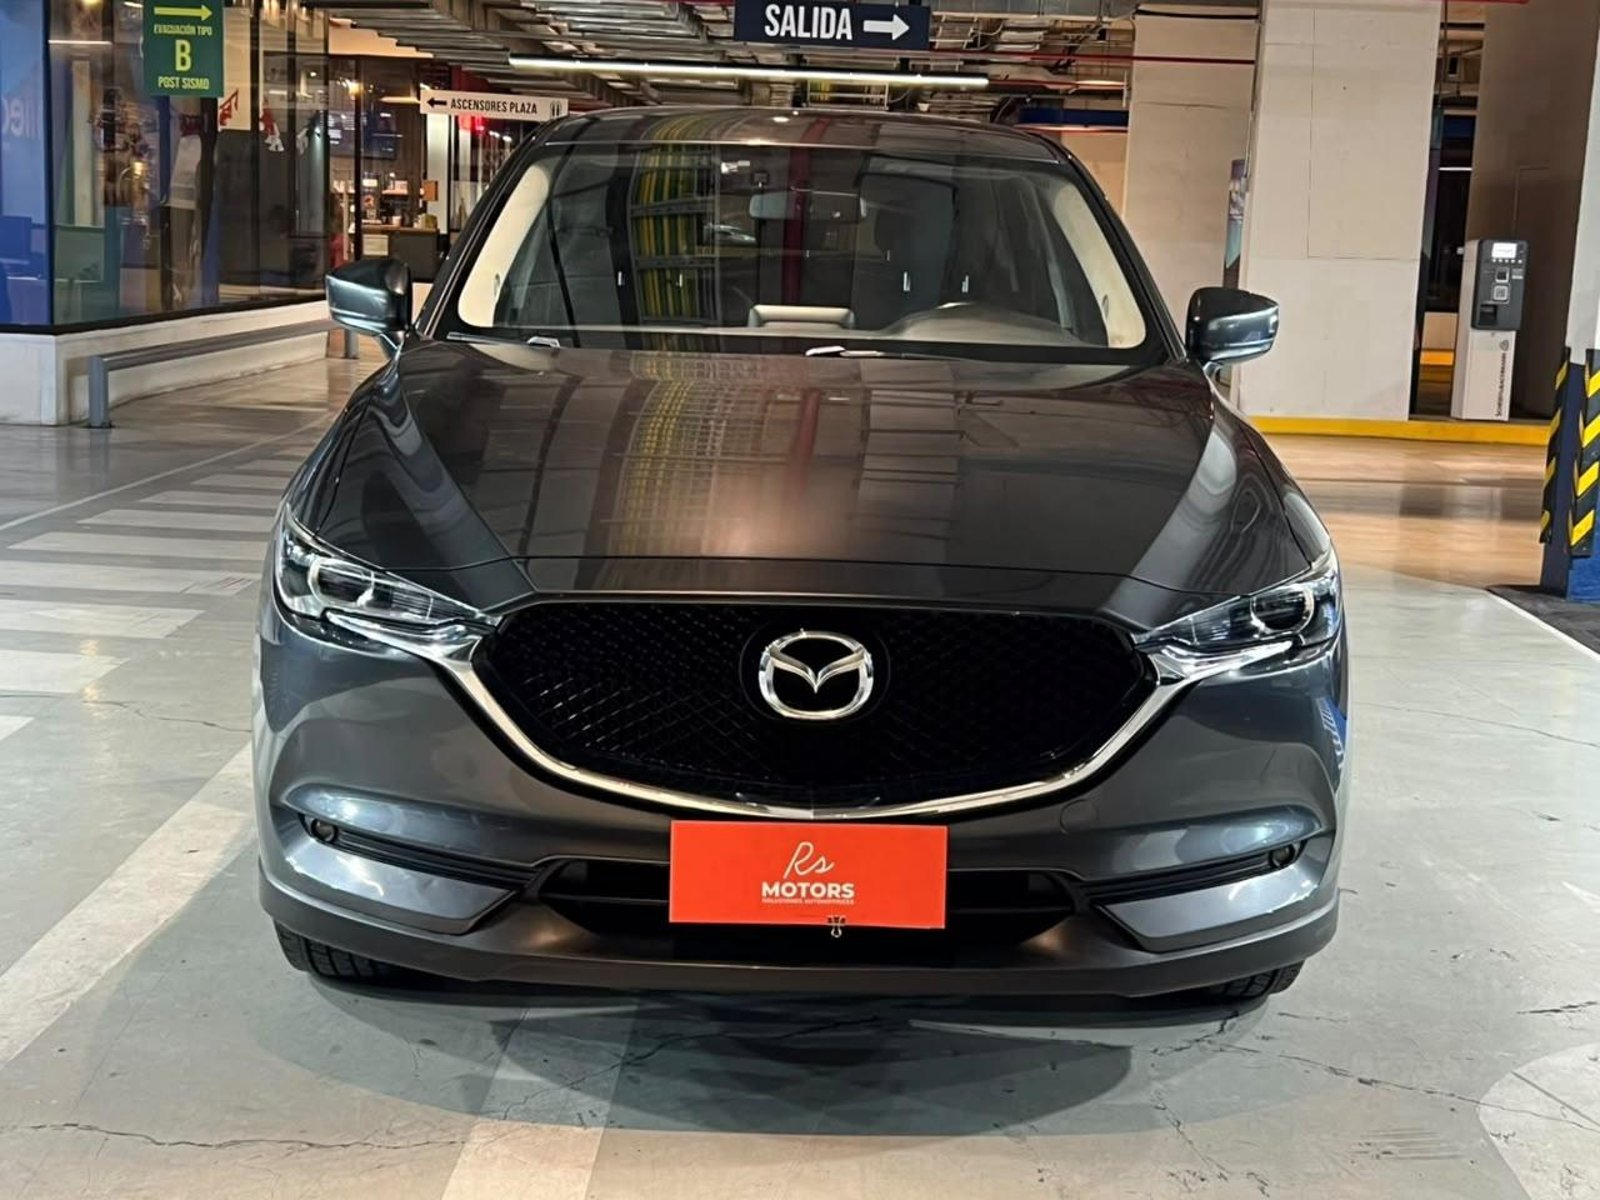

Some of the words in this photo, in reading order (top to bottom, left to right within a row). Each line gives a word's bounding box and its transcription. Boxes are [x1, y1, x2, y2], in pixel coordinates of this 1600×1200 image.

[197, 25, 212, 36] TIPO
[764, 4, 853, 40] SALIDA
[175, 39, 192, 71] B
[158, 76, 179, 89] POST
[182, 77, 210, 90] SISMO
[451, 98, 507, 113] ASCENSORES
[509, 102, 538, 114] PLAZA
[783, 841, 835, 880] Rs
[761, 881, 855, 899] MOTORS
